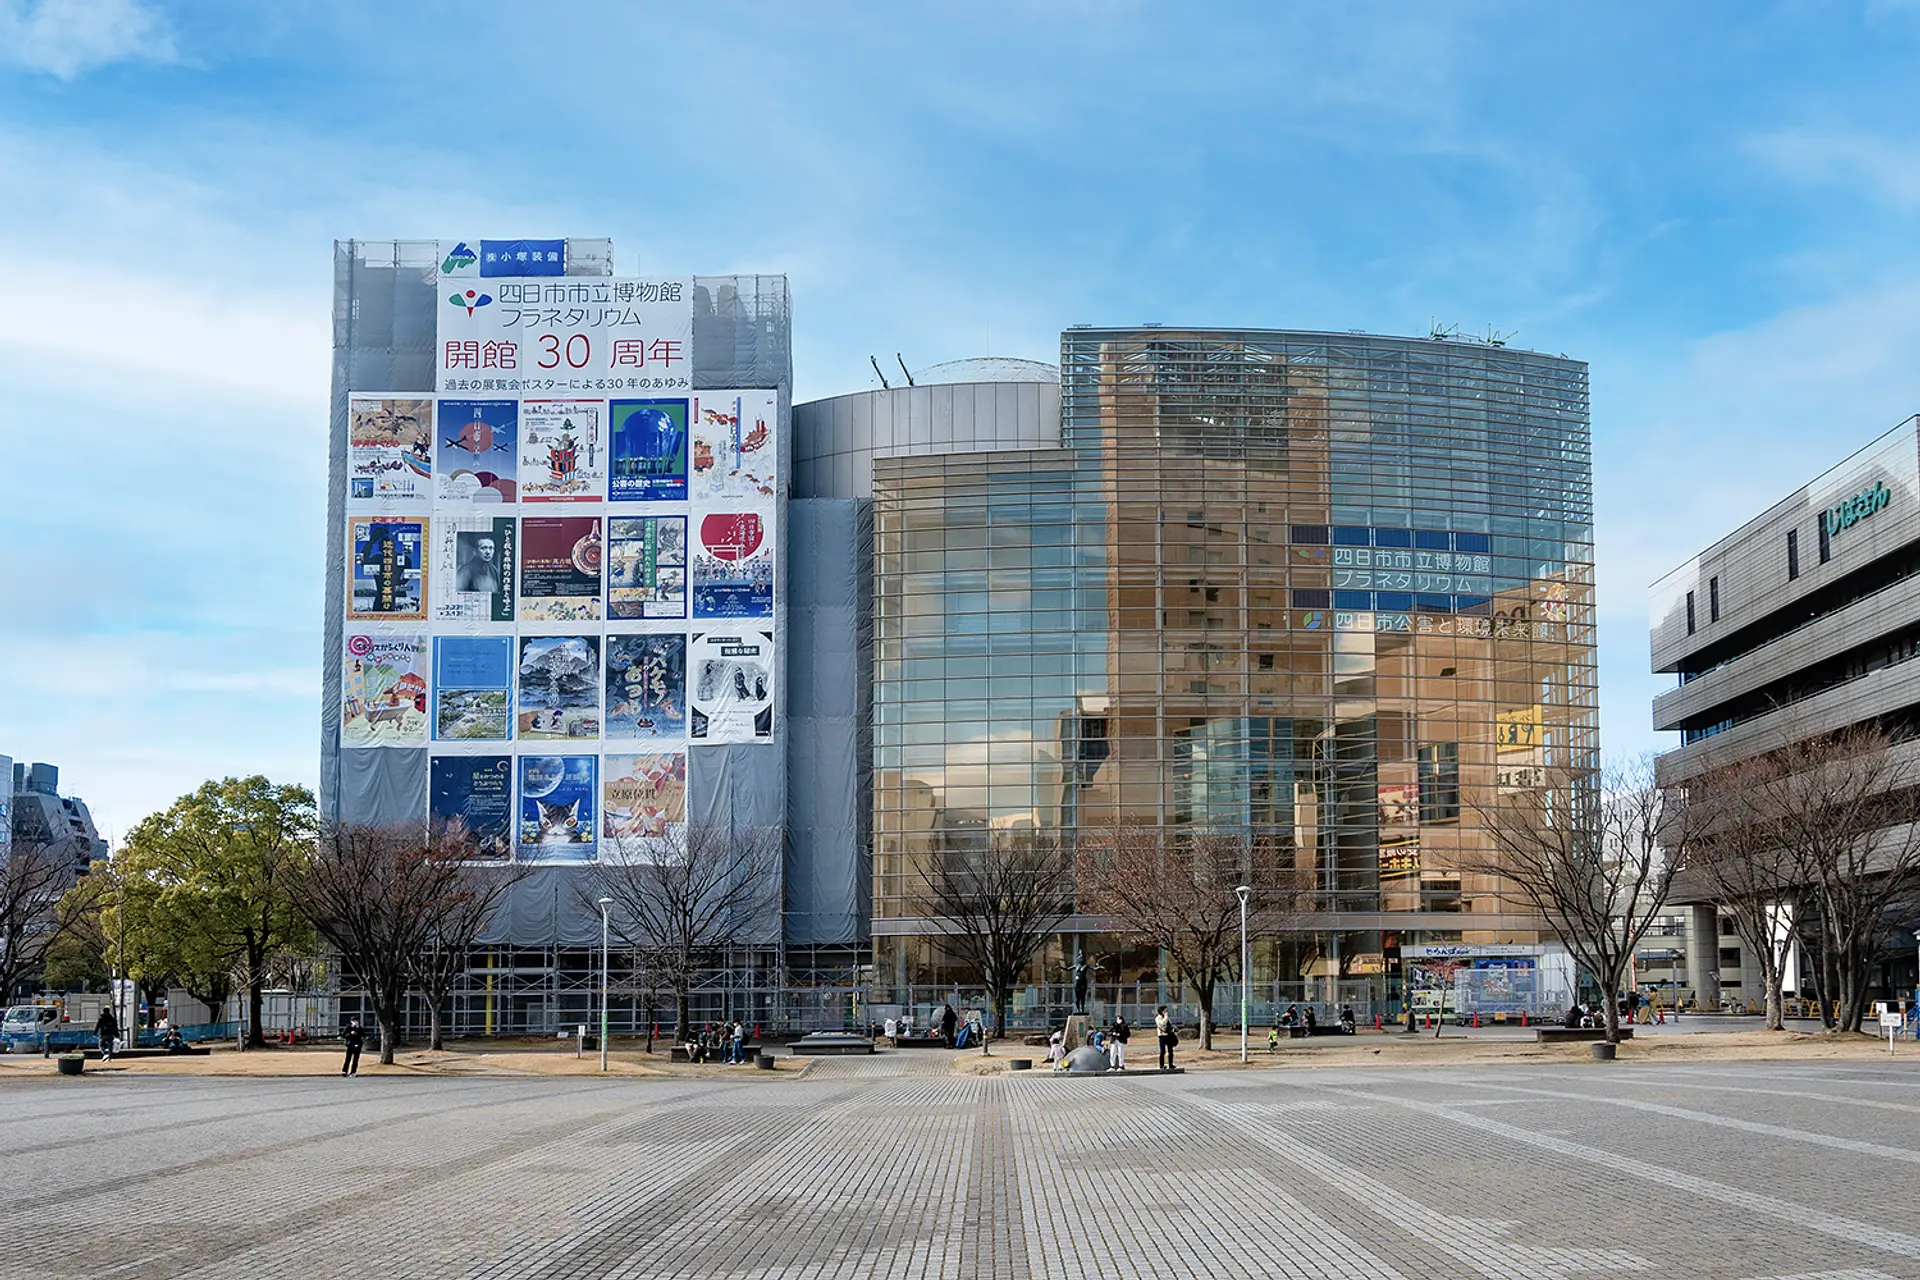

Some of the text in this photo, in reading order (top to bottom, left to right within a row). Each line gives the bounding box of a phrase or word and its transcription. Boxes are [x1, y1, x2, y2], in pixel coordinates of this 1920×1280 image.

[499, 281, 683, 304] 四日市市立博物館
[445, 333, 684, 369] 開館 30 周年
[1825, 481, 1891, 536] じばさん
[1334, 548, 1490, 573] 四日市市立博物館
[1335, 571, 1472, 593] プラネタリウム
[1335, 613, 1548, 639] 四日市公害と環境未来館
